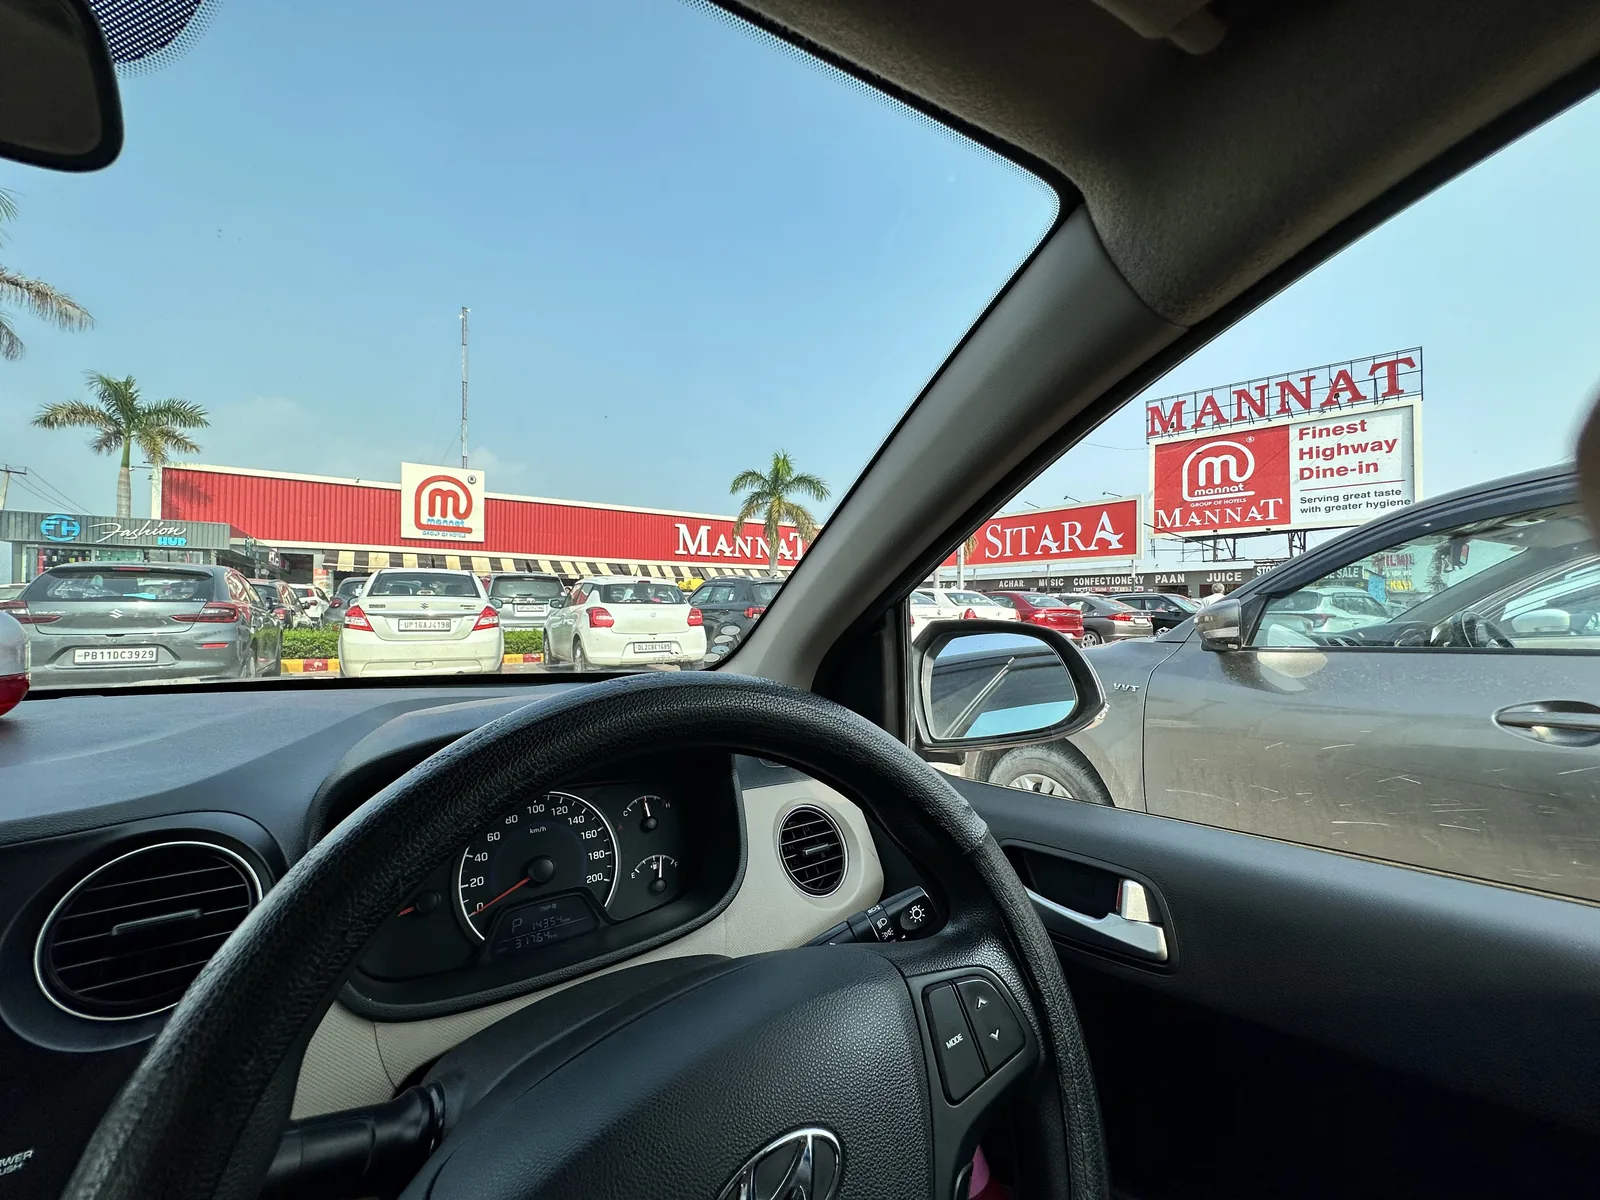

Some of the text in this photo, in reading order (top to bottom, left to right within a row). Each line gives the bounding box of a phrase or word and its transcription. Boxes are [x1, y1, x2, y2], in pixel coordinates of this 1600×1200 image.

[1147, 356, 1416, 436] MANNAT
[1298, 420, 1368, 440] Finest
[1299, 438, 1398, 461] Highway
[1299, 461, 1378, 480] Dine-in
[1194, 483, 1244, 496] mannat
[1300, 488, 1402, 504] Serving great taste
[1300, 498, 1411, 514] with greater hygiene
[1156, 498, 1282, 528] MANNAT
[89, 520, 186, 543] Fashion
[985, 510, 1124, 558] SITARA
[1336, 567, 1359, 578] SALE
[999, 580, 1024, 588] ACHAR
[1074, 576, 1145, 586] CONFECTIONERY
[1155, 574, 1185, 584] PAAN
[1206, 572, 1242, 582] JUICE
[84, 650, 154, 661] PB11DC3929
[526, 804, 545, 814] 100
[551, 806, 568, 816] 120
[505, 814, 518, 824] 80
[568, 815, 585, 826] 140
[530, 826, 546, 834] km/h
[581, 830, 598, 840] 160
[487, 832, 500, 842] 60
[474, 852, 488, 862] 40
[588, 850, 605, 860] 180
[470, 876, 484, 888] 20
[586, 872, 603, 884] 200
[476, 902, 484, 912] 0
[946, 1032, 964, 1049] MODE
